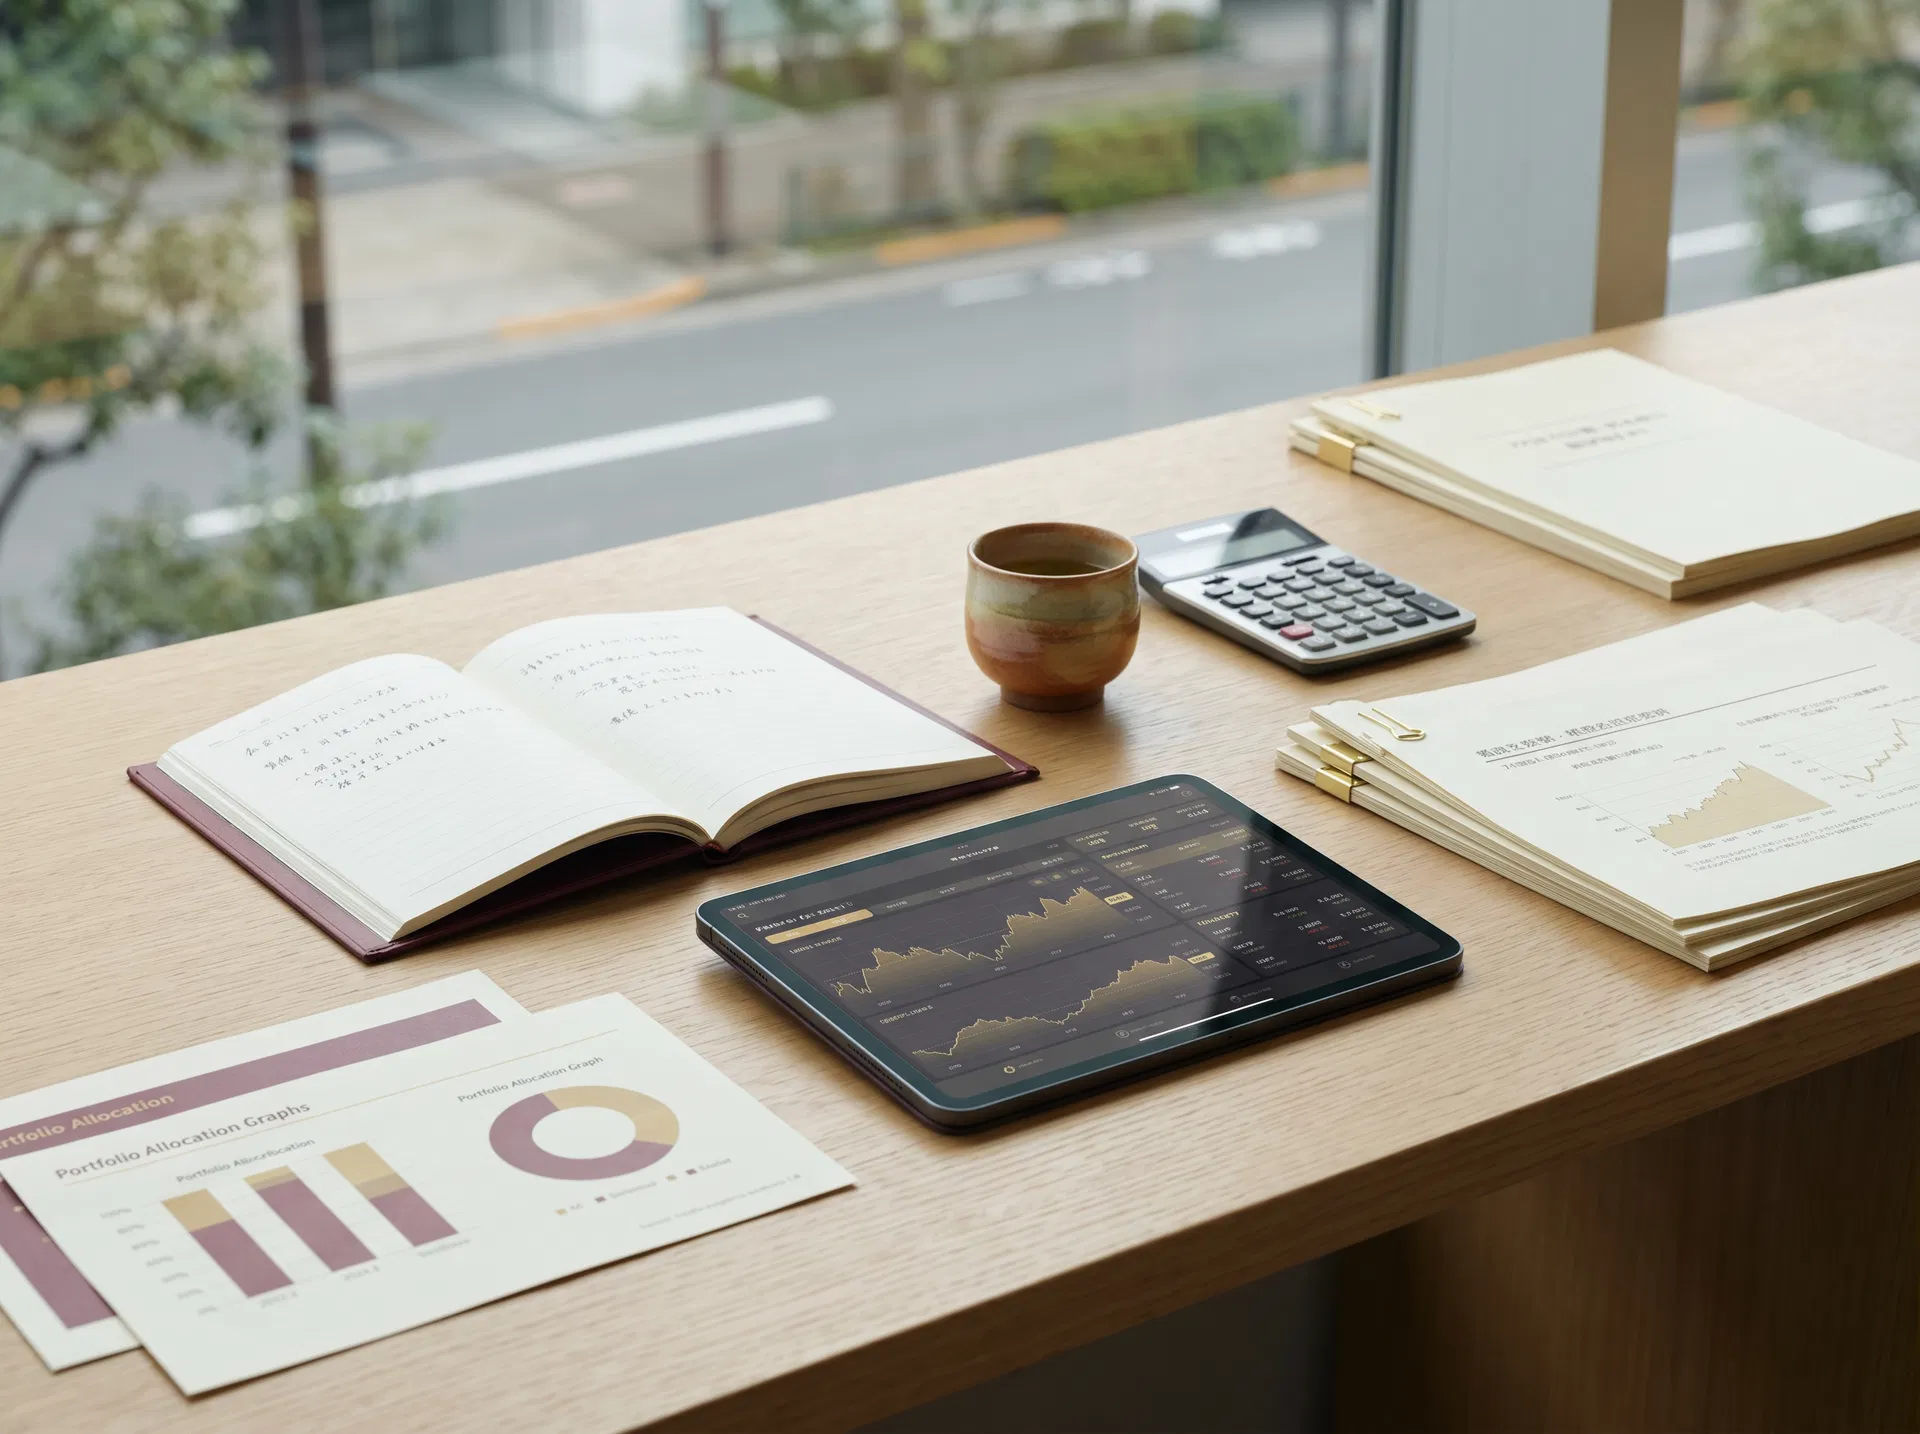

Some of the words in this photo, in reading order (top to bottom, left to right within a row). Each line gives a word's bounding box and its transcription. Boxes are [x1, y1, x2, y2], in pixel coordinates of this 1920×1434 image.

[457, 1083, 509, 1102] Portfolio
[511, 1066, 567, 1088] Allocation
[568, 1056, 604, 1072] Graph
[0, 1125, 65, 1149] rtfolio
[71, 1094, 175, 1130] Allocation
[54, 1151, 141, 1180] Portfolio
[145, 1122, 241, 1157] Allocation
[243, 1102, 311, 1128] Graphs
[176, 1163, 231, 1183] Portfolio
